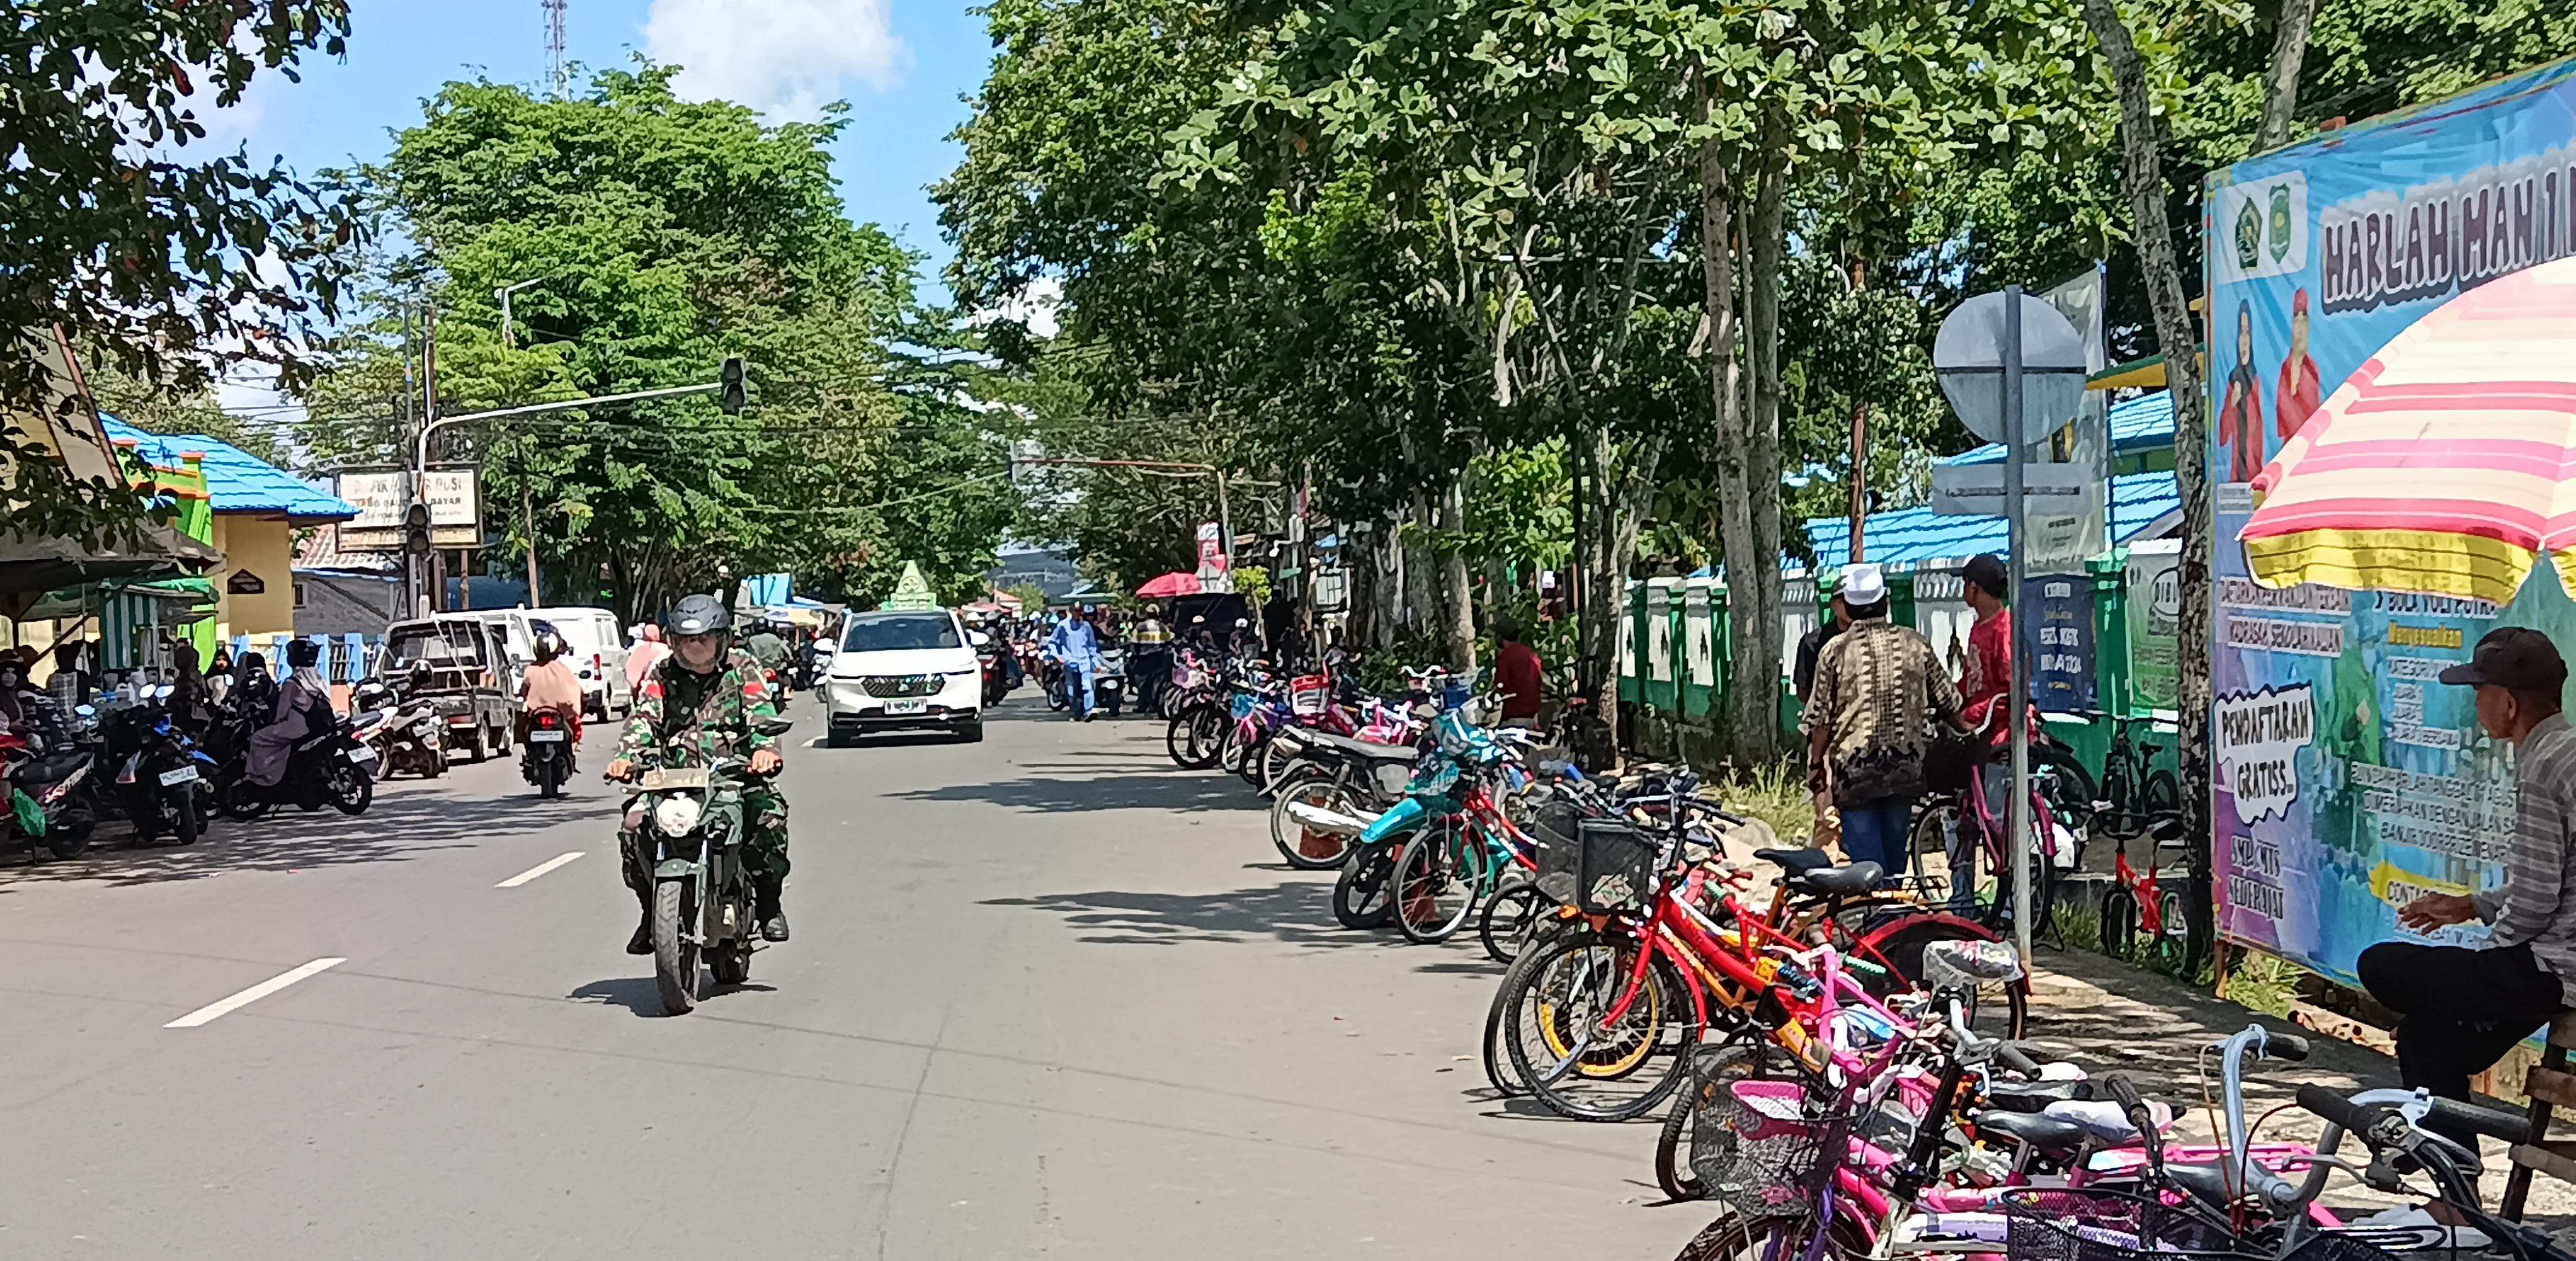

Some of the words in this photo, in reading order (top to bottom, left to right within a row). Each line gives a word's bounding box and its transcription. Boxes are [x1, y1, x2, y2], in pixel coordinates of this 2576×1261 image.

[2324, 197, 2452, 302] HARLAH
[2461, 176, 2536, 280] MAN
[2221, 700, 2309, 749] PENDAFTARAN
